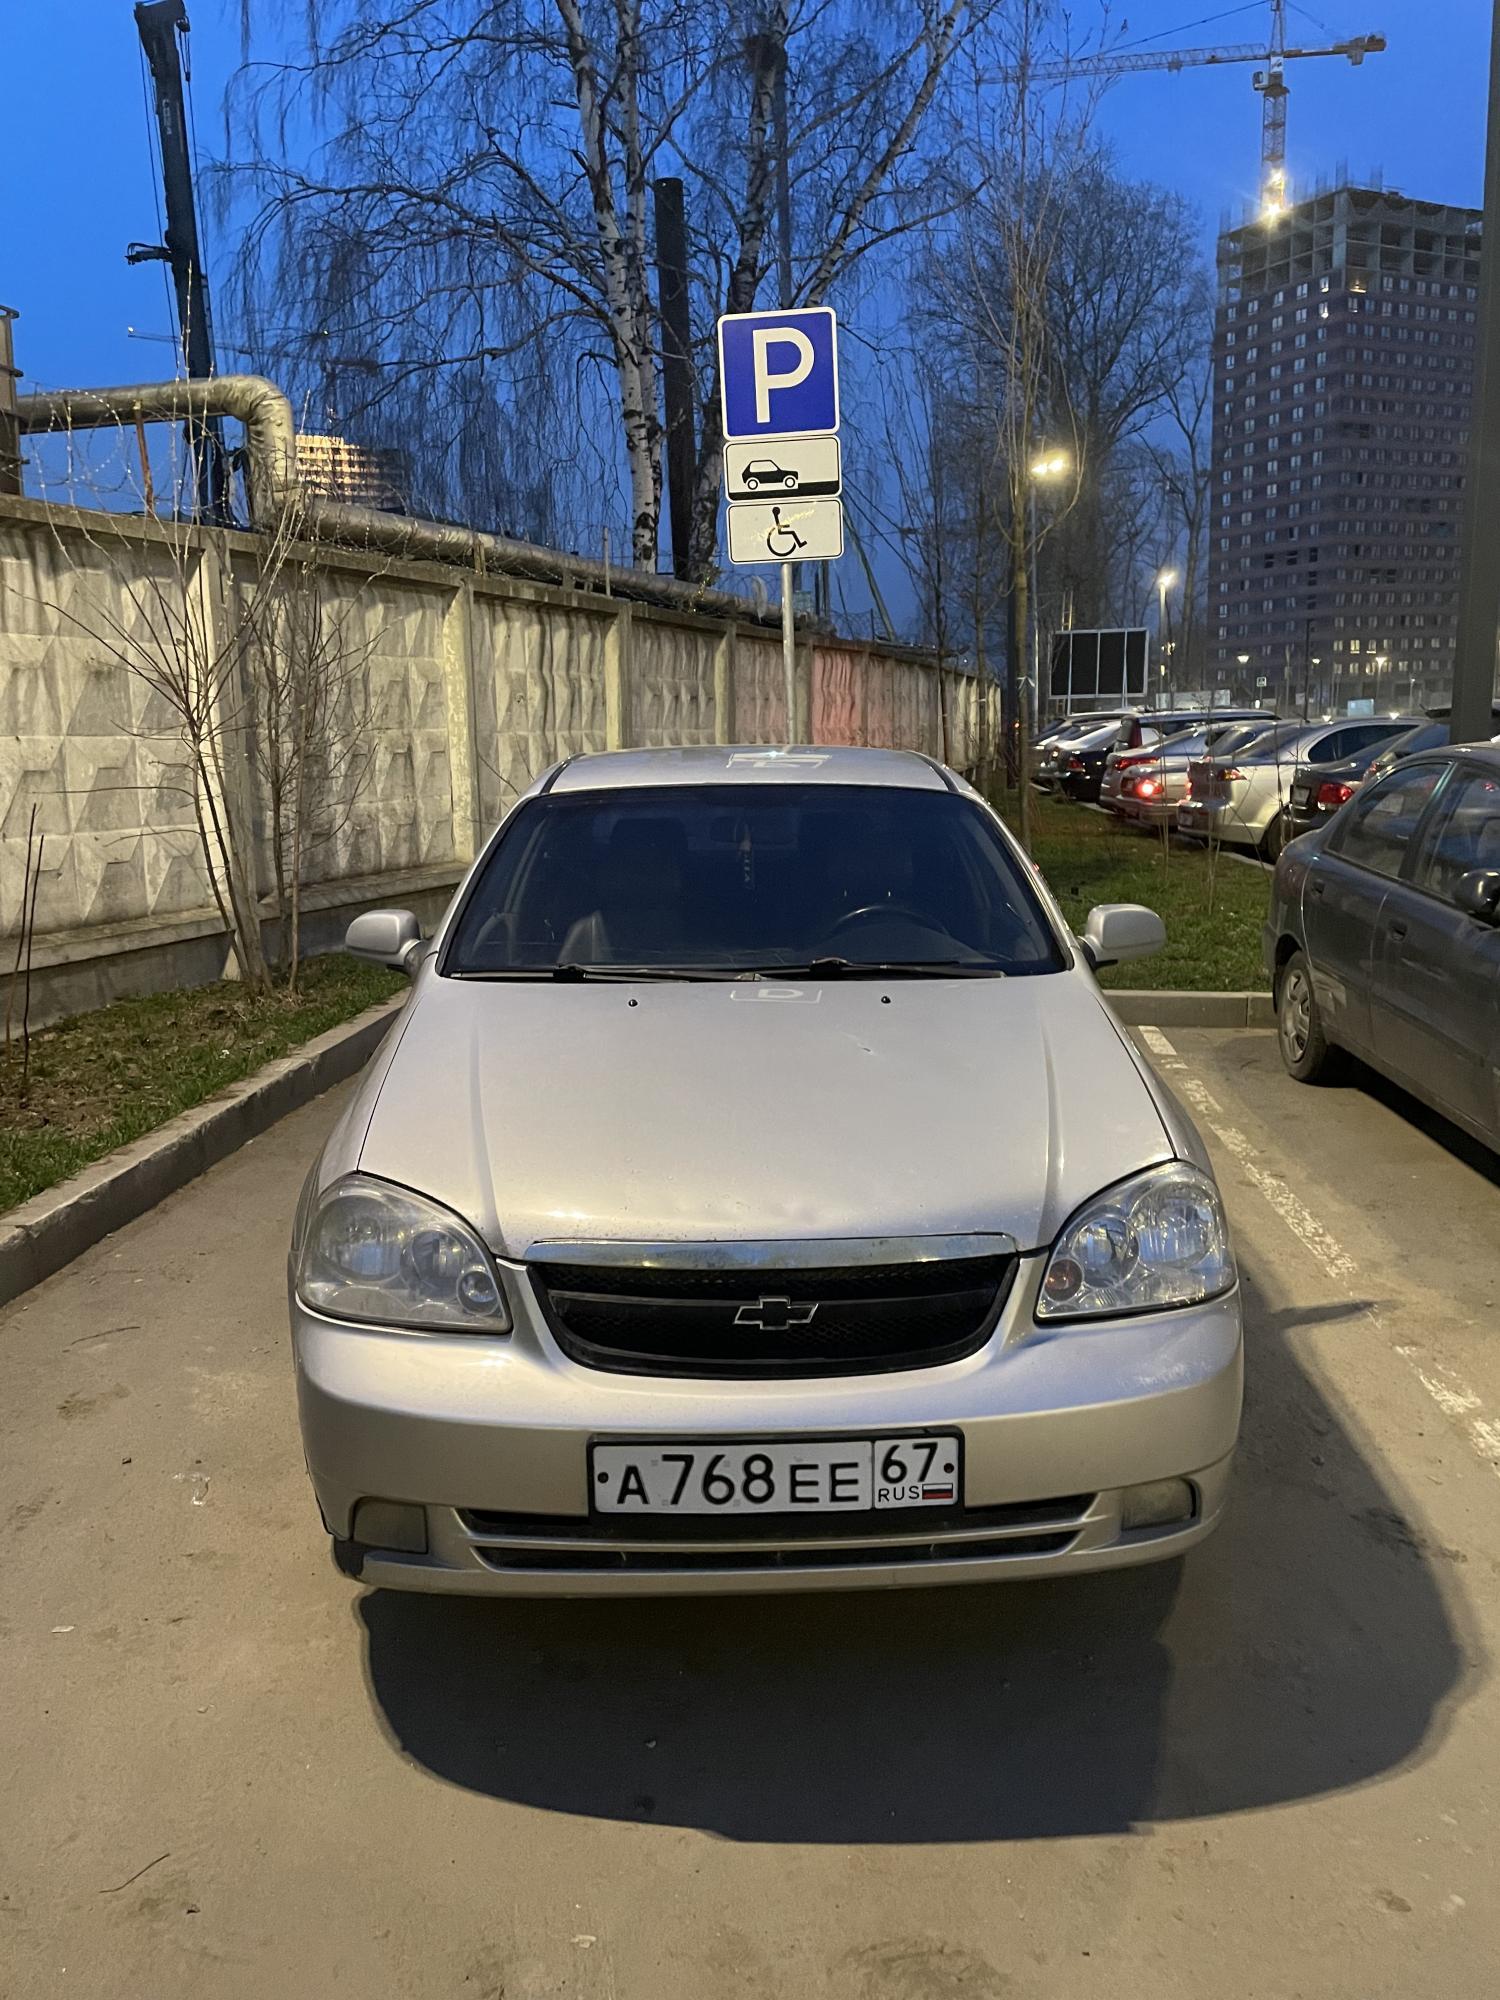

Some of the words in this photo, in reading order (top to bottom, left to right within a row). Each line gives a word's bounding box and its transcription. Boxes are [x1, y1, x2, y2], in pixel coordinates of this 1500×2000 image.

[752, 327, 815, 423] P
[881, 1441, 938, 1484] 67
[877, 1485, 920, 1502] RUS
